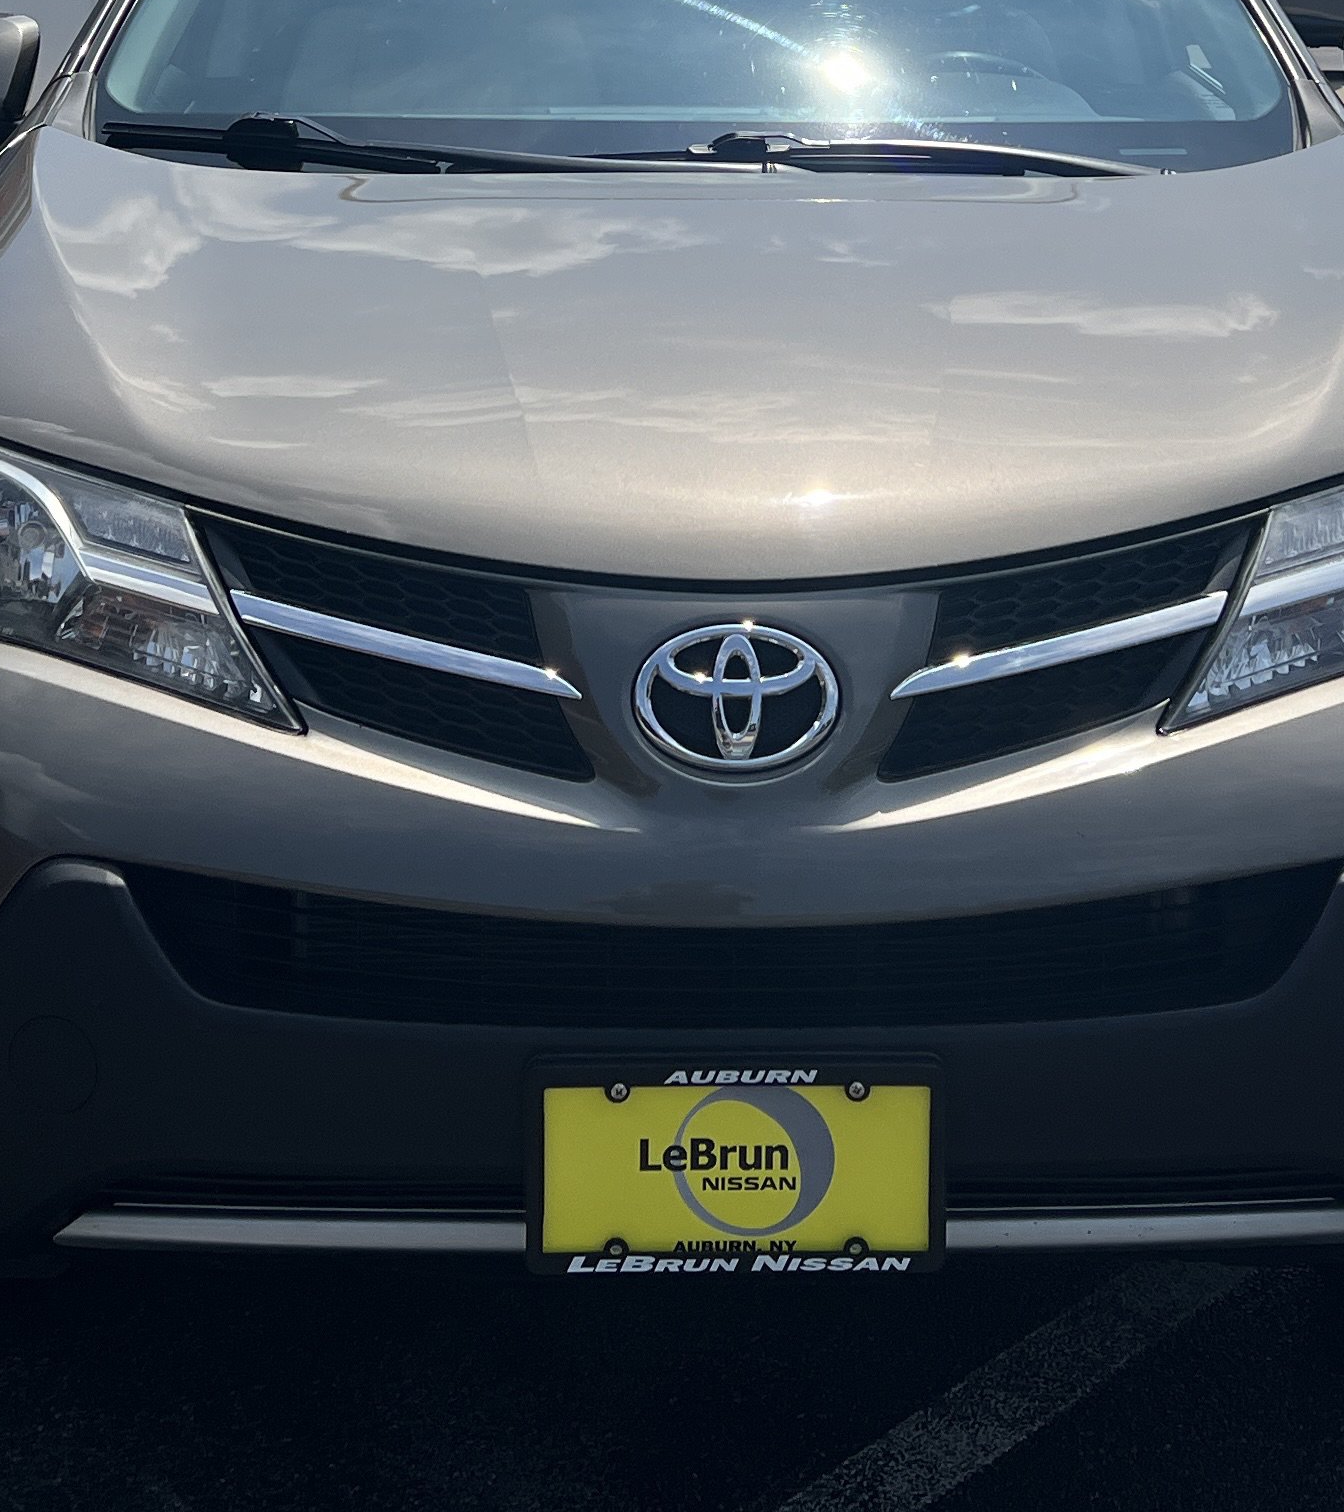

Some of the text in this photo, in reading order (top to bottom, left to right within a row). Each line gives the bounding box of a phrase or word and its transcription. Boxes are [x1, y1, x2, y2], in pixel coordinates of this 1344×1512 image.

[664, 1069, 819, 1085] AUBURN
[639, 1138, 789, 1172] LeBrun
[701, 1176, 797, 1191] NISSAN
[769, 1239, 797, 1254] NY
